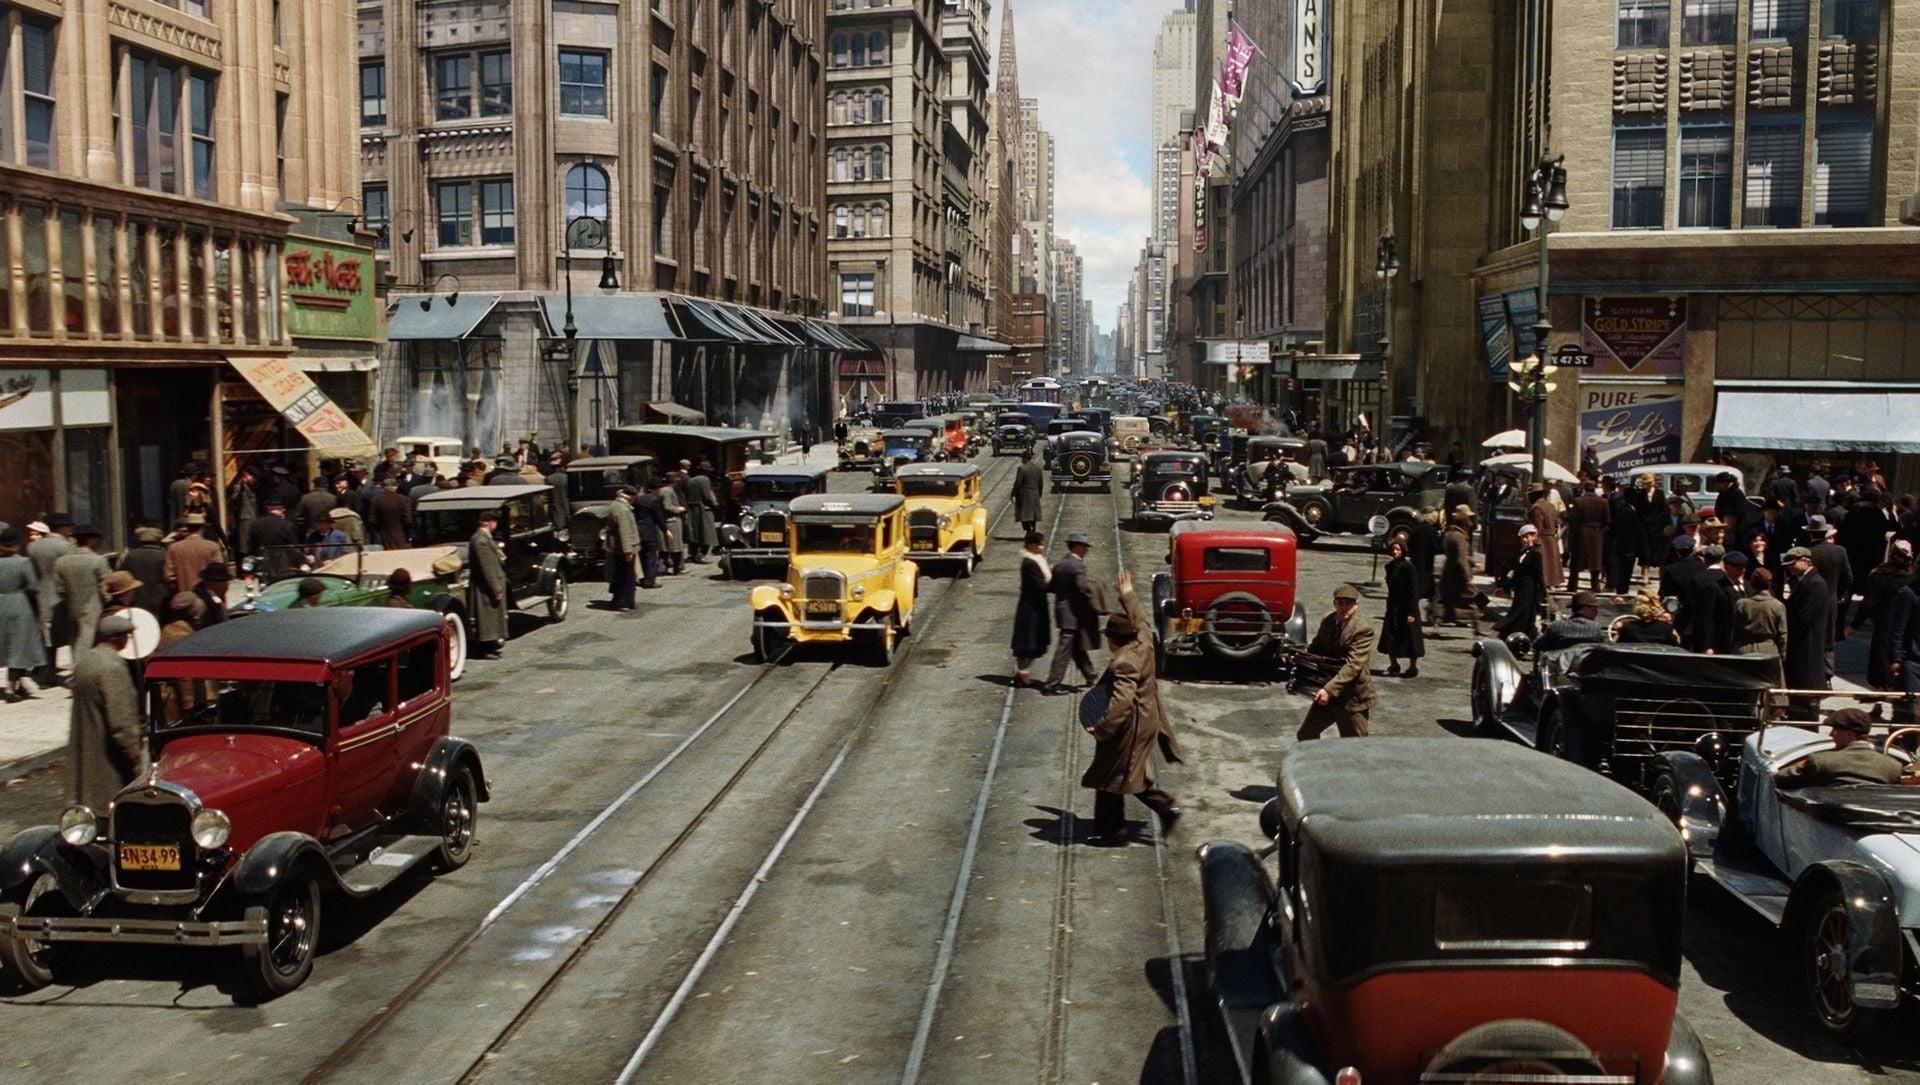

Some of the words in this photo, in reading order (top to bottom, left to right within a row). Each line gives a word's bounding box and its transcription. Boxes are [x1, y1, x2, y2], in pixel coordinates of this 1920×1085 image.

[1611, 307, 1654, 315] GOTHAM
[1593, 317, 1628, 332] GOLD
[1631, 317, 1672, 332] STRIPE
[1559, 355, 1573, 365] 47
[1587, 391, 1639, 409] PURE
